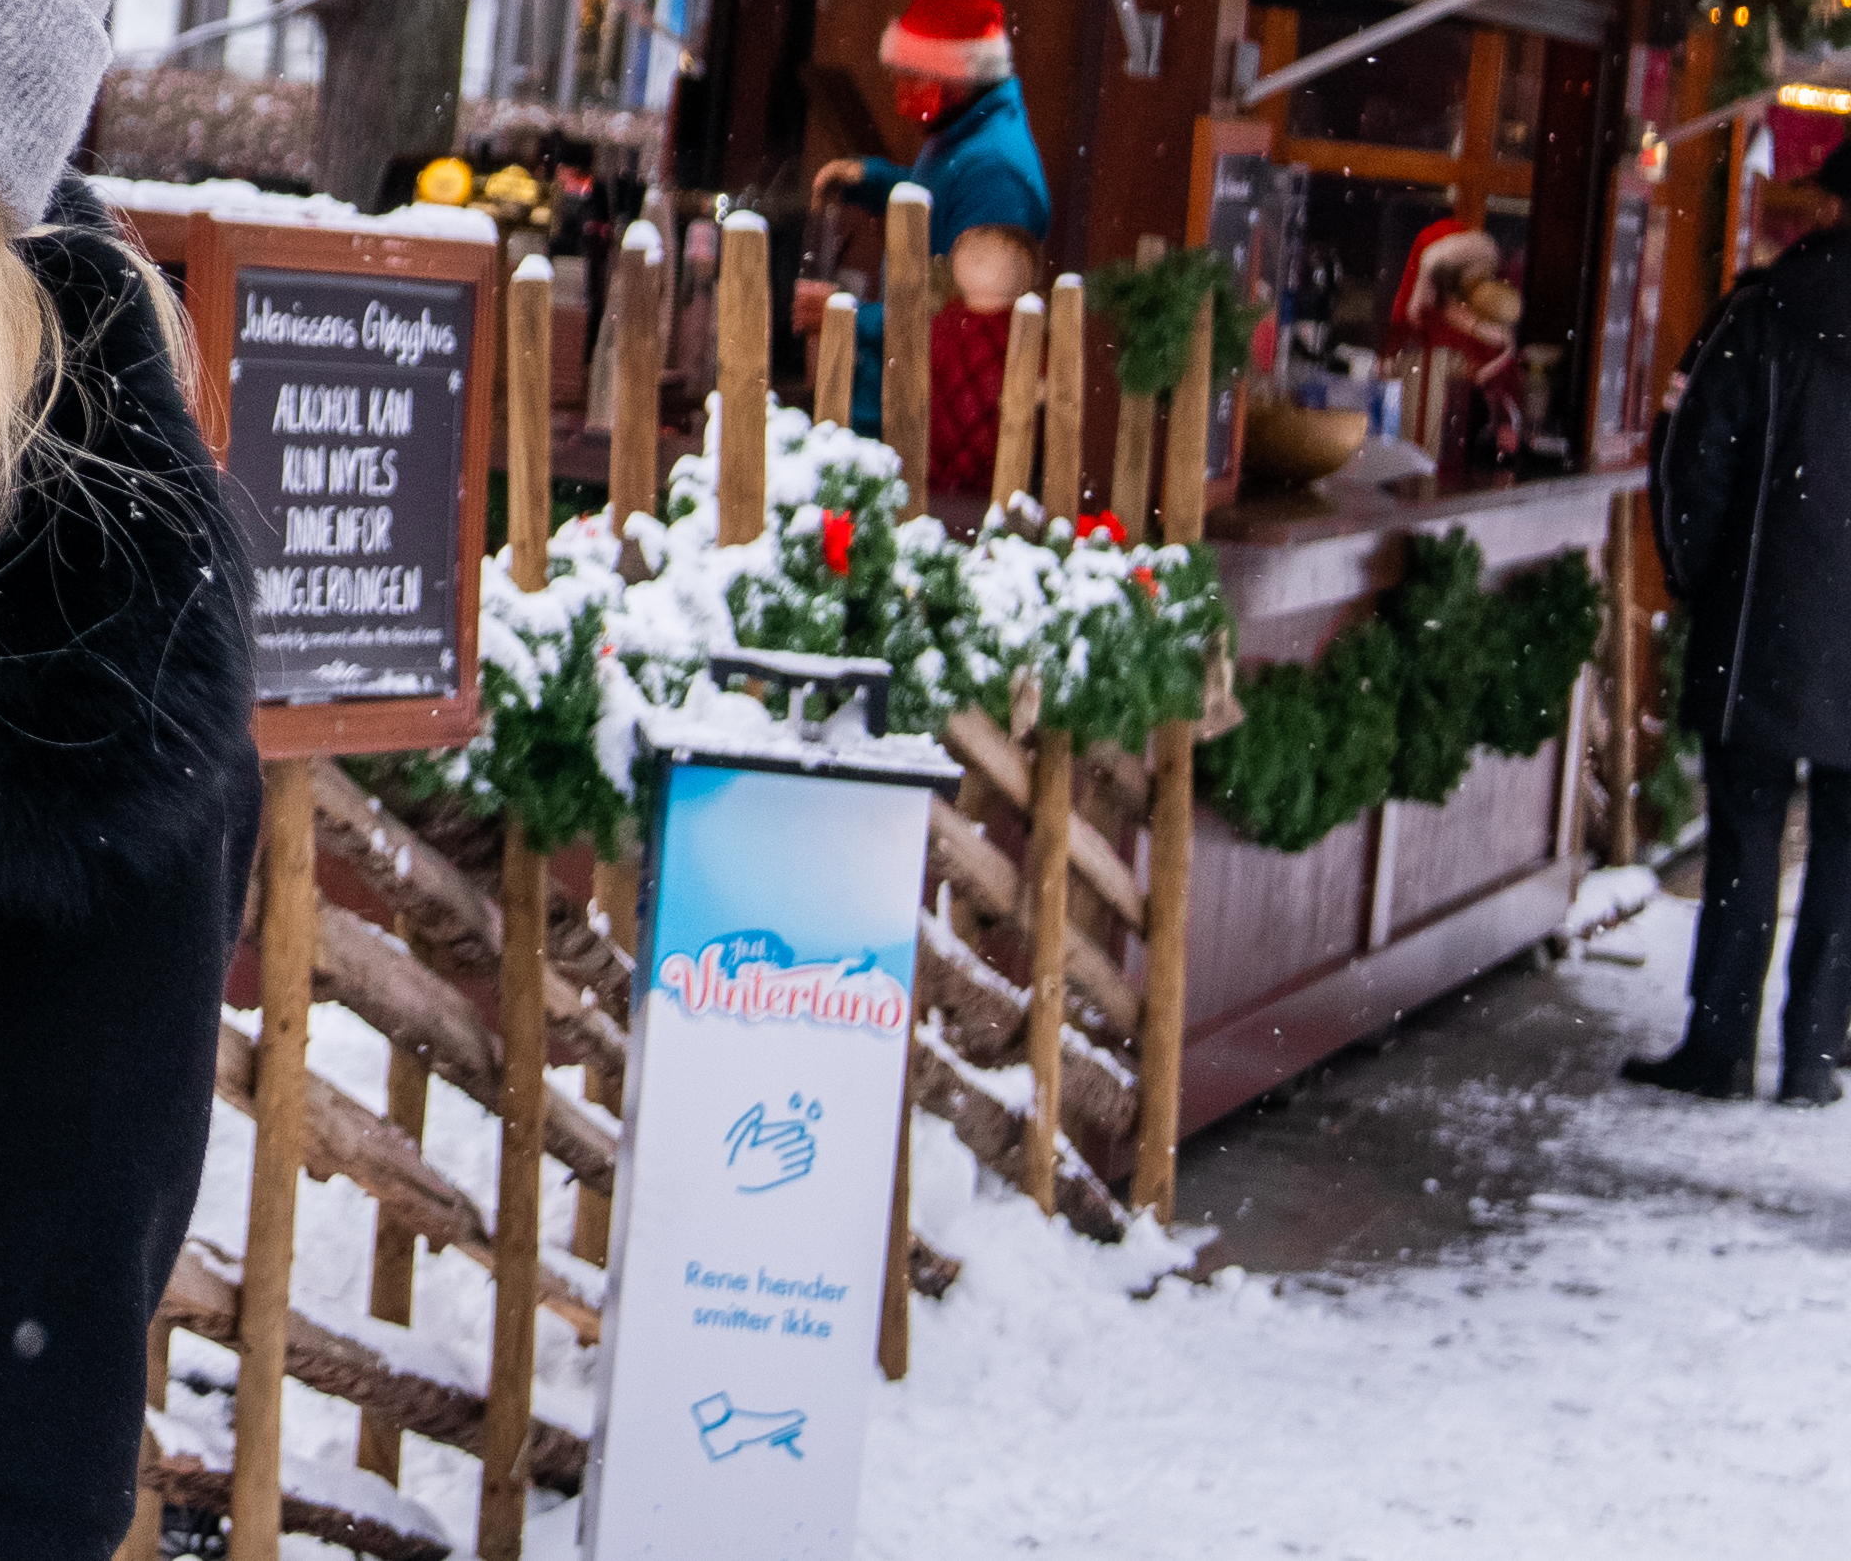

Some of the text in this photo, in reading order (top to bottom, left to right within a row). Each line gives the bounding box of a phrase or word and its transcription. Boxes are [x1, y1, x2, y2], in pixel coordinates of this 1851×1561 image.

[241, 292, 458, 366] Julenissens Gløgghus
[272, 383, 415, 436] ALKOHOL KAN
[281, 444, 399, 497] KUN NYTES
[283, 505, 394, 555] INNENFOR
[252, 565, 422, 617] NNGJERDINGEN
[661, 943, 905, 1030] Vinterland
[685, 1260, 849, 1302] Rene hender
[693, 1304, 833, 1339] smitter ikke
